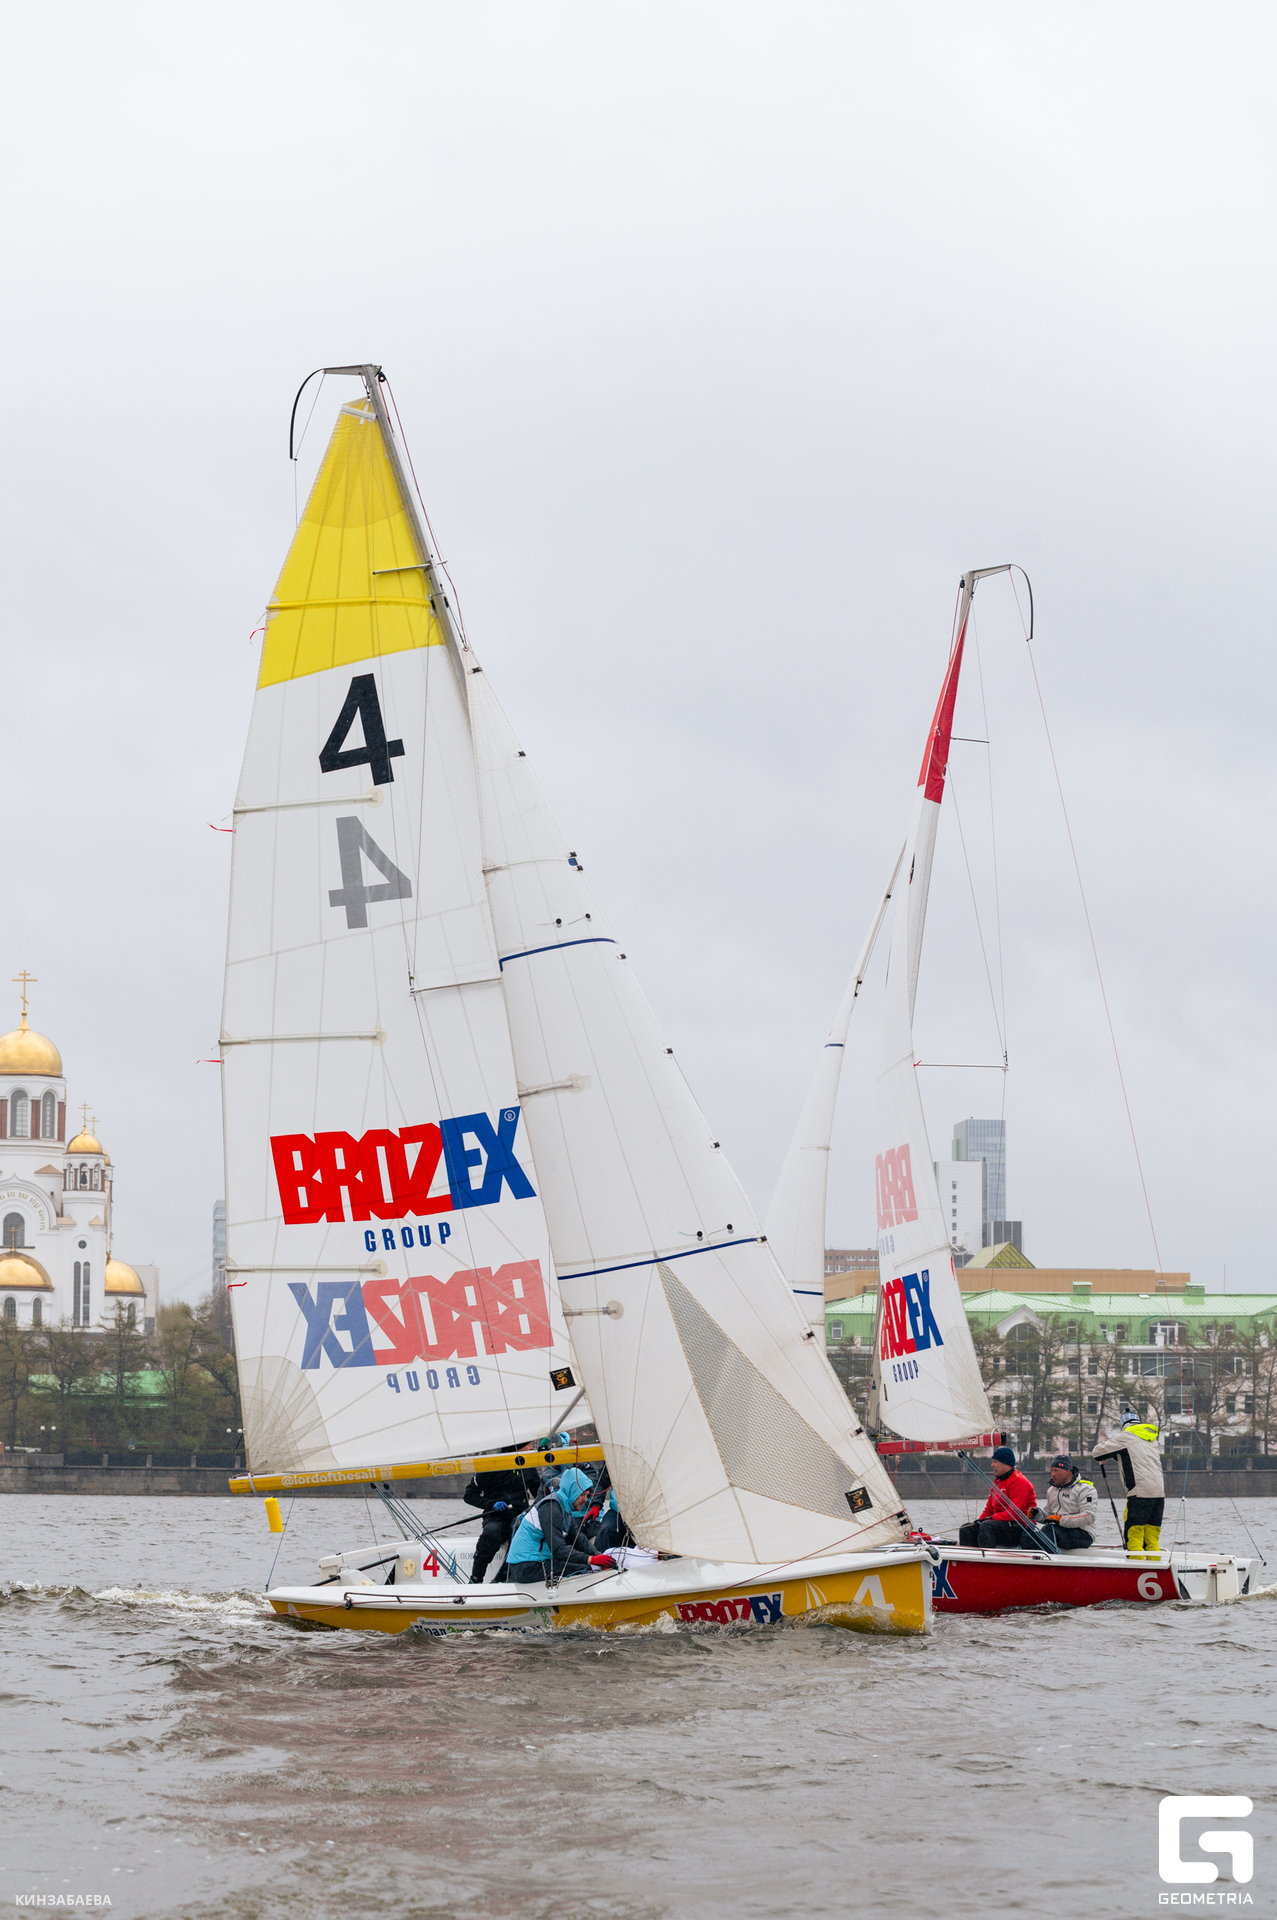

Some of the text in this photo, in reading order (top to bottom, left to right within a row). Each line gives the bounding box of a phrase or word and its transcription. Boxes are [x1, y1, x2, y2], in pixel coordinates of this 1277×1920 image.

[318, 673, 405, 786] 4
[270, 1106, 537, 1225] BROZEX
[364, 1222, 452, 1252] GROUP
[892, 1360, 919, 1383] GROUP
[281, 1468, 377, 1488] @lordofthesail
[422, 1548, 440, 1578] 4
[1137, 1571, 1163, 1600] 6
